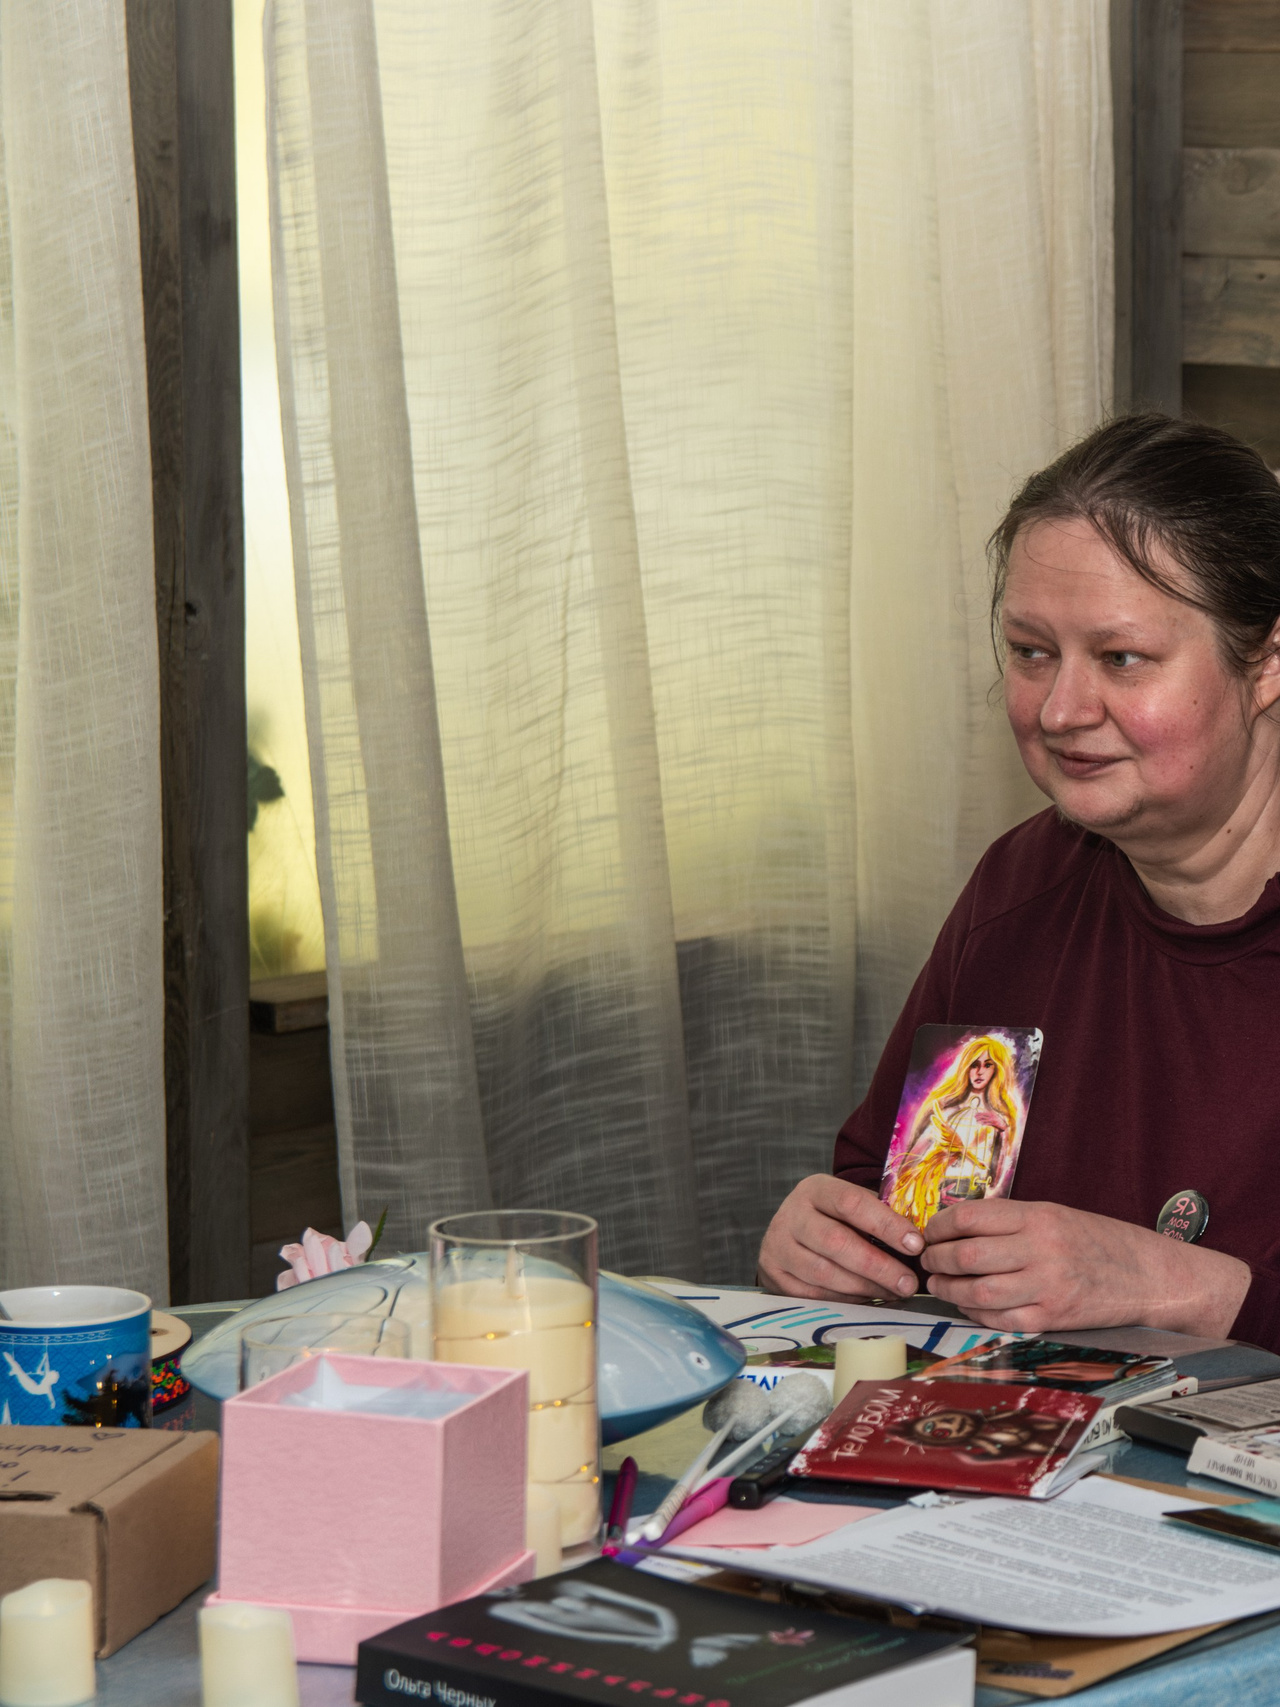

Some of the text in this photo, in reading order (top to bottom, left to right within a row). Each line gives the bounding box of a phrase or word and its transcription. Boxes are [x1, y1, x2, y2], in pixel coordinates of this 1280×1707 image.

[1172, 1197, 1190, 1216] Я
[1167, 1216, 1191, 1231] МОЯ
[383, 1668, 497, 1707] Ольга Черных
